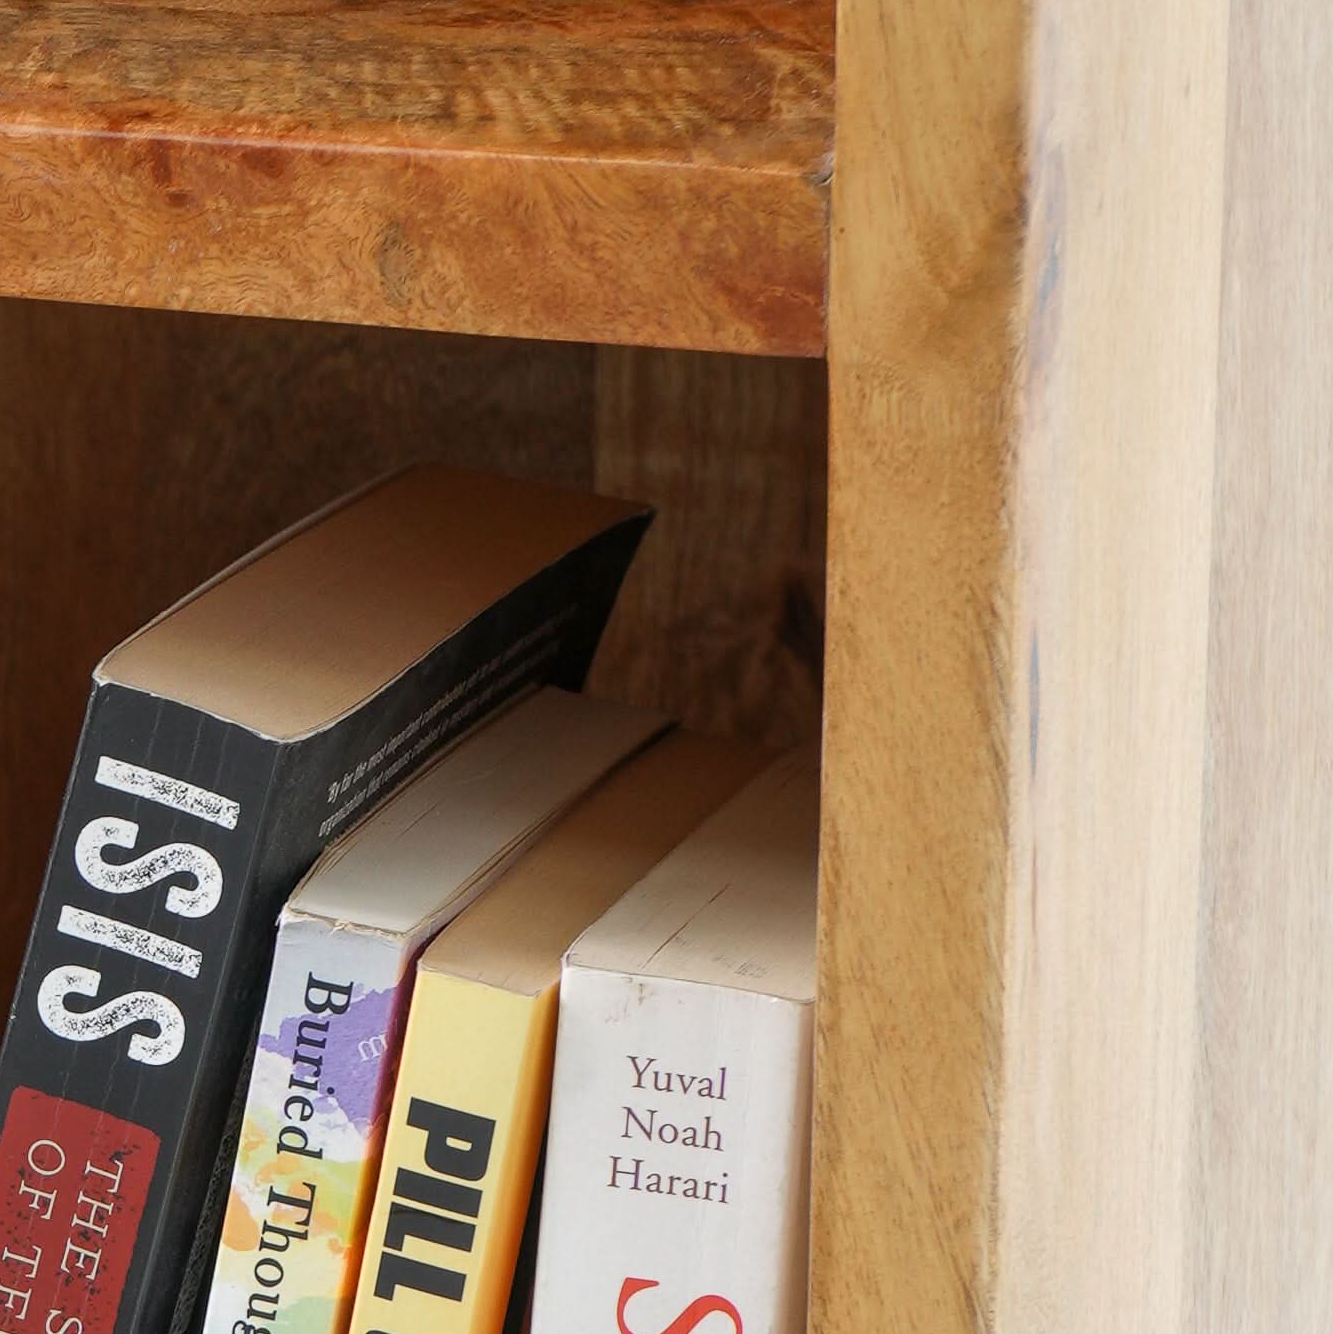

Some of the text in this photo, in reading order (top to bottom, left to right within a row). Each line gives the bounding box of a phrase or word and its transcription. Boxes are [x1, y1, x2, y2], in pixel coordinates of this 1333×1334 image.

[37, 755, 241, 1067] ISIS
[275, 970, 355, 1161] Buried
[626, 1054, 727, 1102] Yuval
[18, 1138, 66, 1220] OF
[606, 1156, 729, 1204] Harari
[620, 1106, 724, 1153] Noah
[60, 1159, 123, 1281] THE
[373, 1096, 496, 1303] PILL
